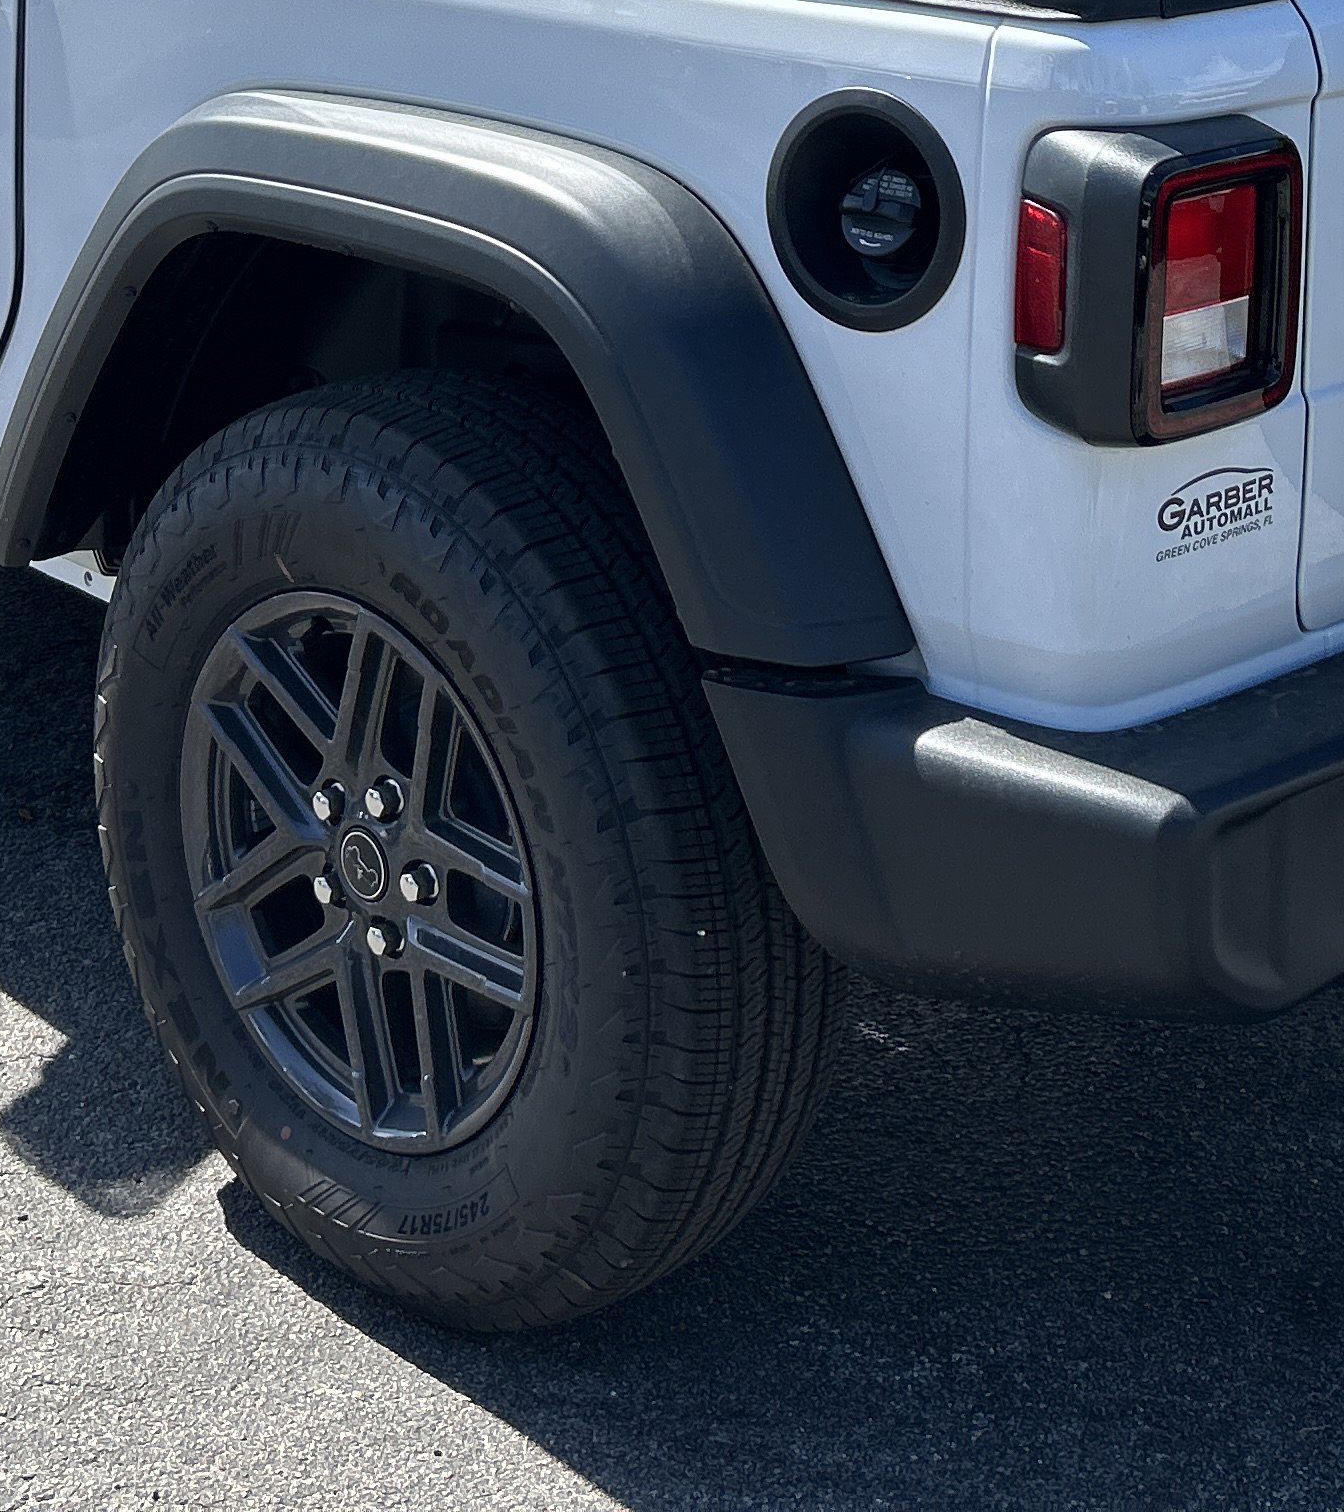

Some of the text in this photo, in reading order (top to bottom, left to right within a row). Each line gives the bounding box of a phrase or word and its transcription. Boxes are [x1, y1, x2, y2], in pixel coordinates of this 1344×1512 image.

[1157, 473, 1274, 531] GARBER
[1181, 497, 1273, 540] AUTOMALL
[1156, 514, 1273, 563] GREEN COVE SPRINGS, FL
[390, 571, 554, 834] ROADIAN
[120, 809, 232, 1097] NEXEN
[397, 1190, 491, 1237] 245/75R17
